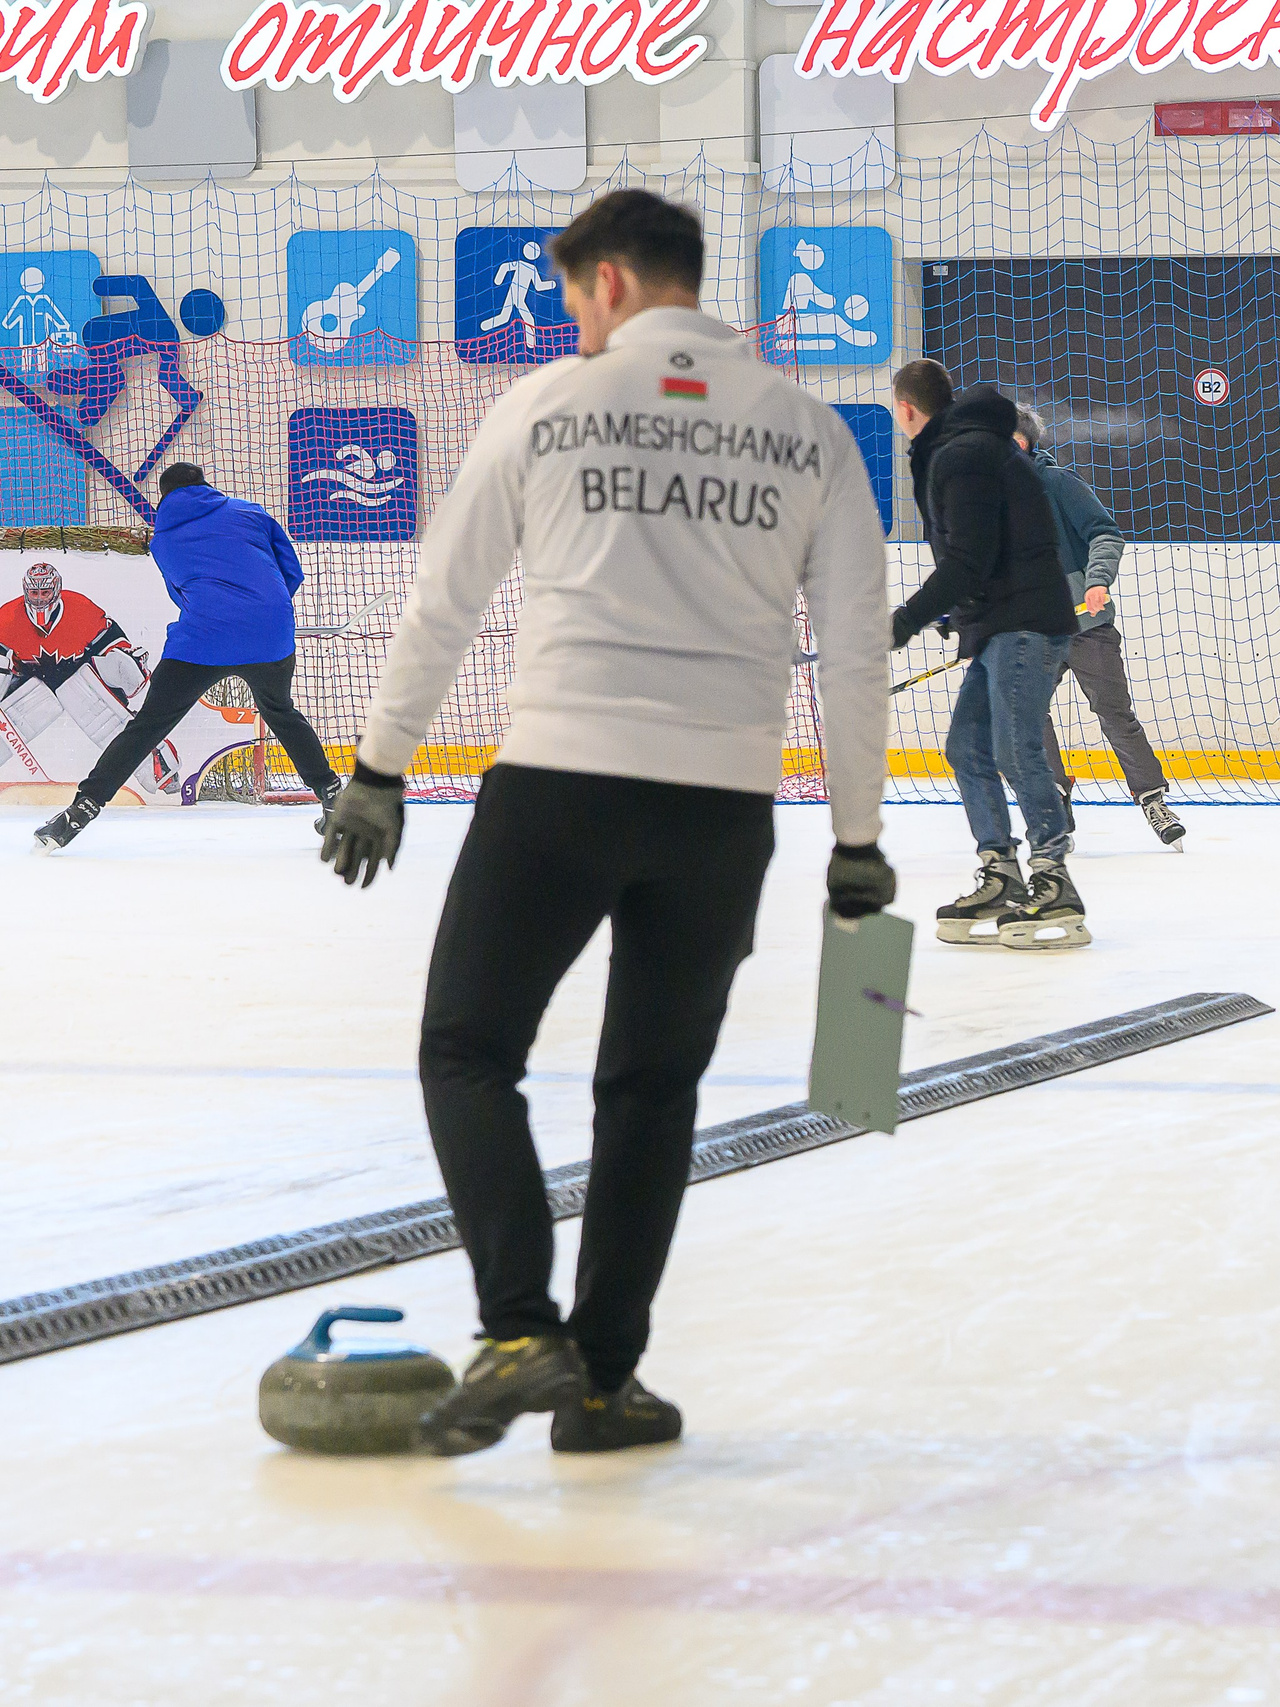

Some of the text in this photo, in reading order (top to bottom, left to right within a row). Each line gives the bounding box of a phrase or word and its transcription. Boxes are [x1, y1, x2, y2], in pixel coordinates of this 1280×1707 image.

[0, 0, 138, 97] им
[229, 0, 700, 94] отличное
[529, 410, 822, 478] DZIAMESHCHANKA
[580, 466, 781, 530] BELARUS
[236, 711, 246, 722] 7
[5, 731, 39, 776] CANADA
[185, 784, 193, 796] 5
